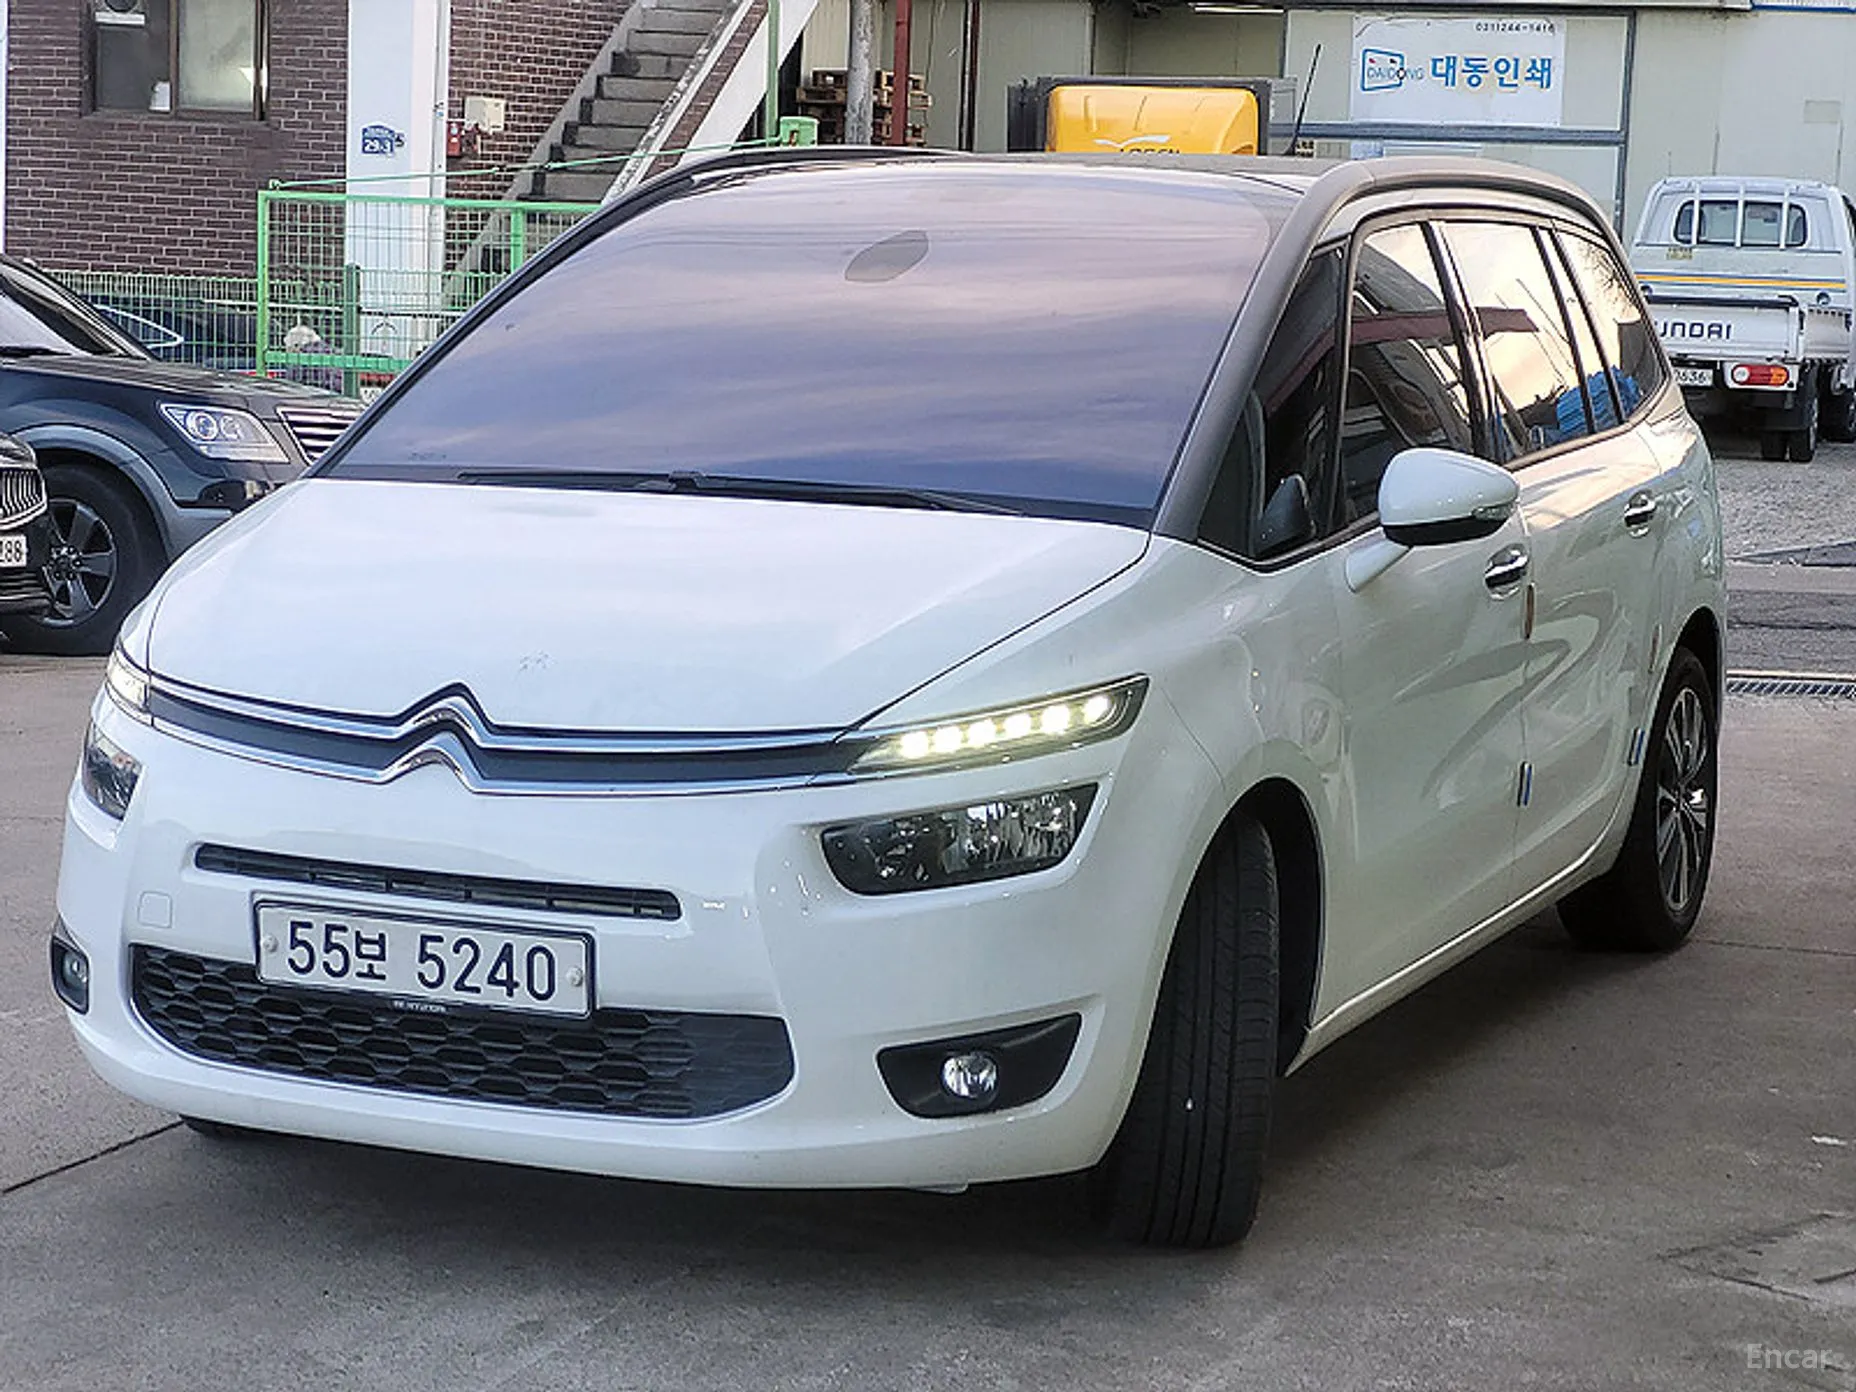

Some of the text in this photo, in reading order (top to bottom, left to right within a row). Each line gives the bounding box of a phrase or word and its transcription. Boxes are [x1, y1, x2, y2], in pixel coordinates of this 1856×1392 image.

[1431, 56, 1552, 89] 대동인쇄
[1654, 322, 1732, 340] UNDAI
[287, 920, 556, 1001] 55보 5240
